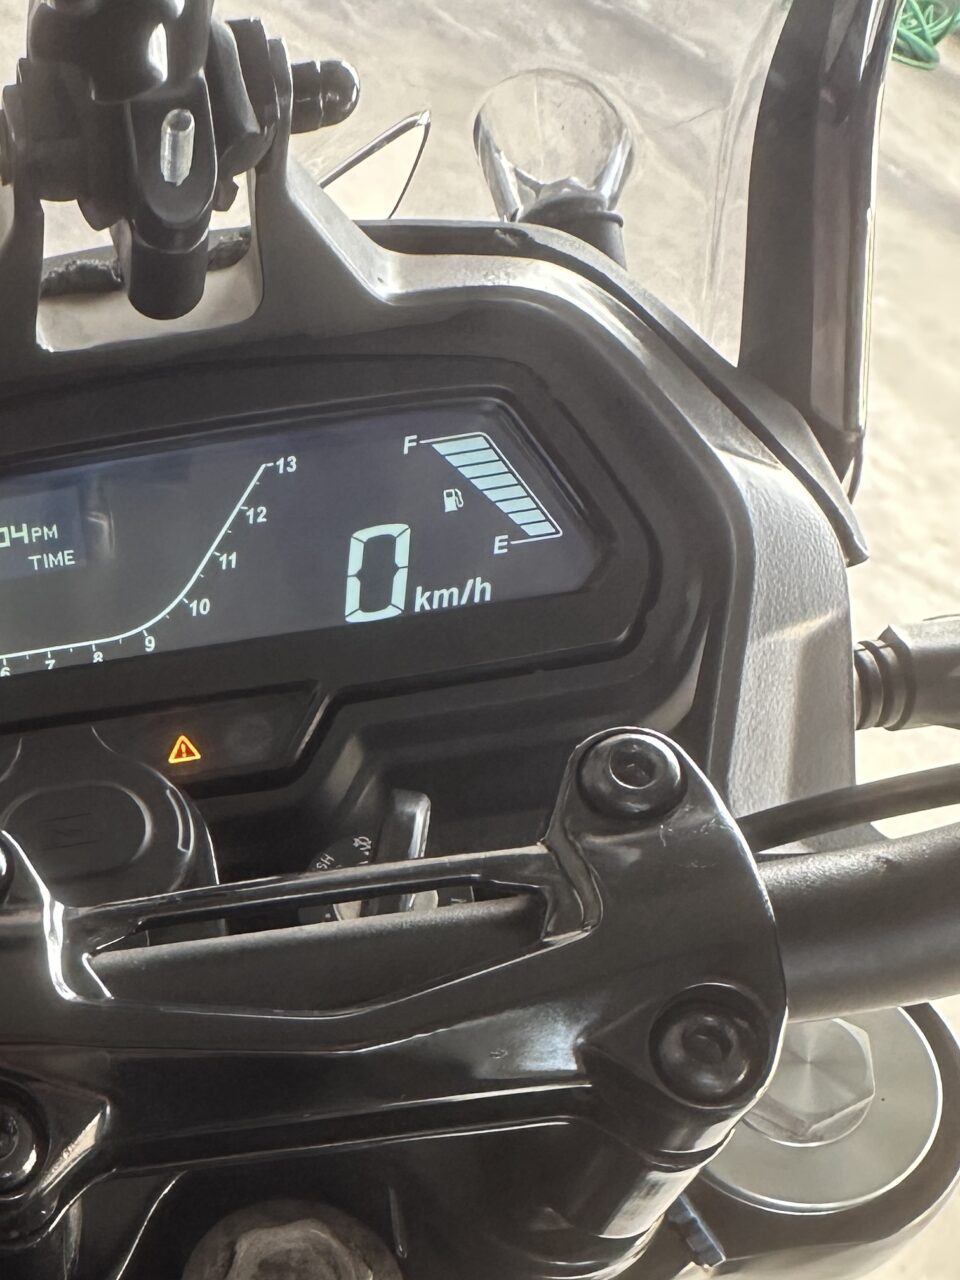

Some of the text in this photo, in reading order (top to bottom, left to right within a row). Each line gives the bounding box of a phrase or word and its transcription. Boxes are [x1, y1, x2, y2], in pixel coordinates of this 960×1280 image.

[403, 434, 418, 455] F
[31, 524, 58, 543] PM
[493, 534, 509, 555] E
[27, 549, 76, 571] TIME
[44, 659, 56, 670] 7
[145, 636, 156, 652] 9
[189, 598, 211, 617] 10
[219, 552, 238, 570] 11
[245, 507, 268, 525] 12
[275, 455, 298, 474] 13
[344, 523, 492, 623] 0 km/h
